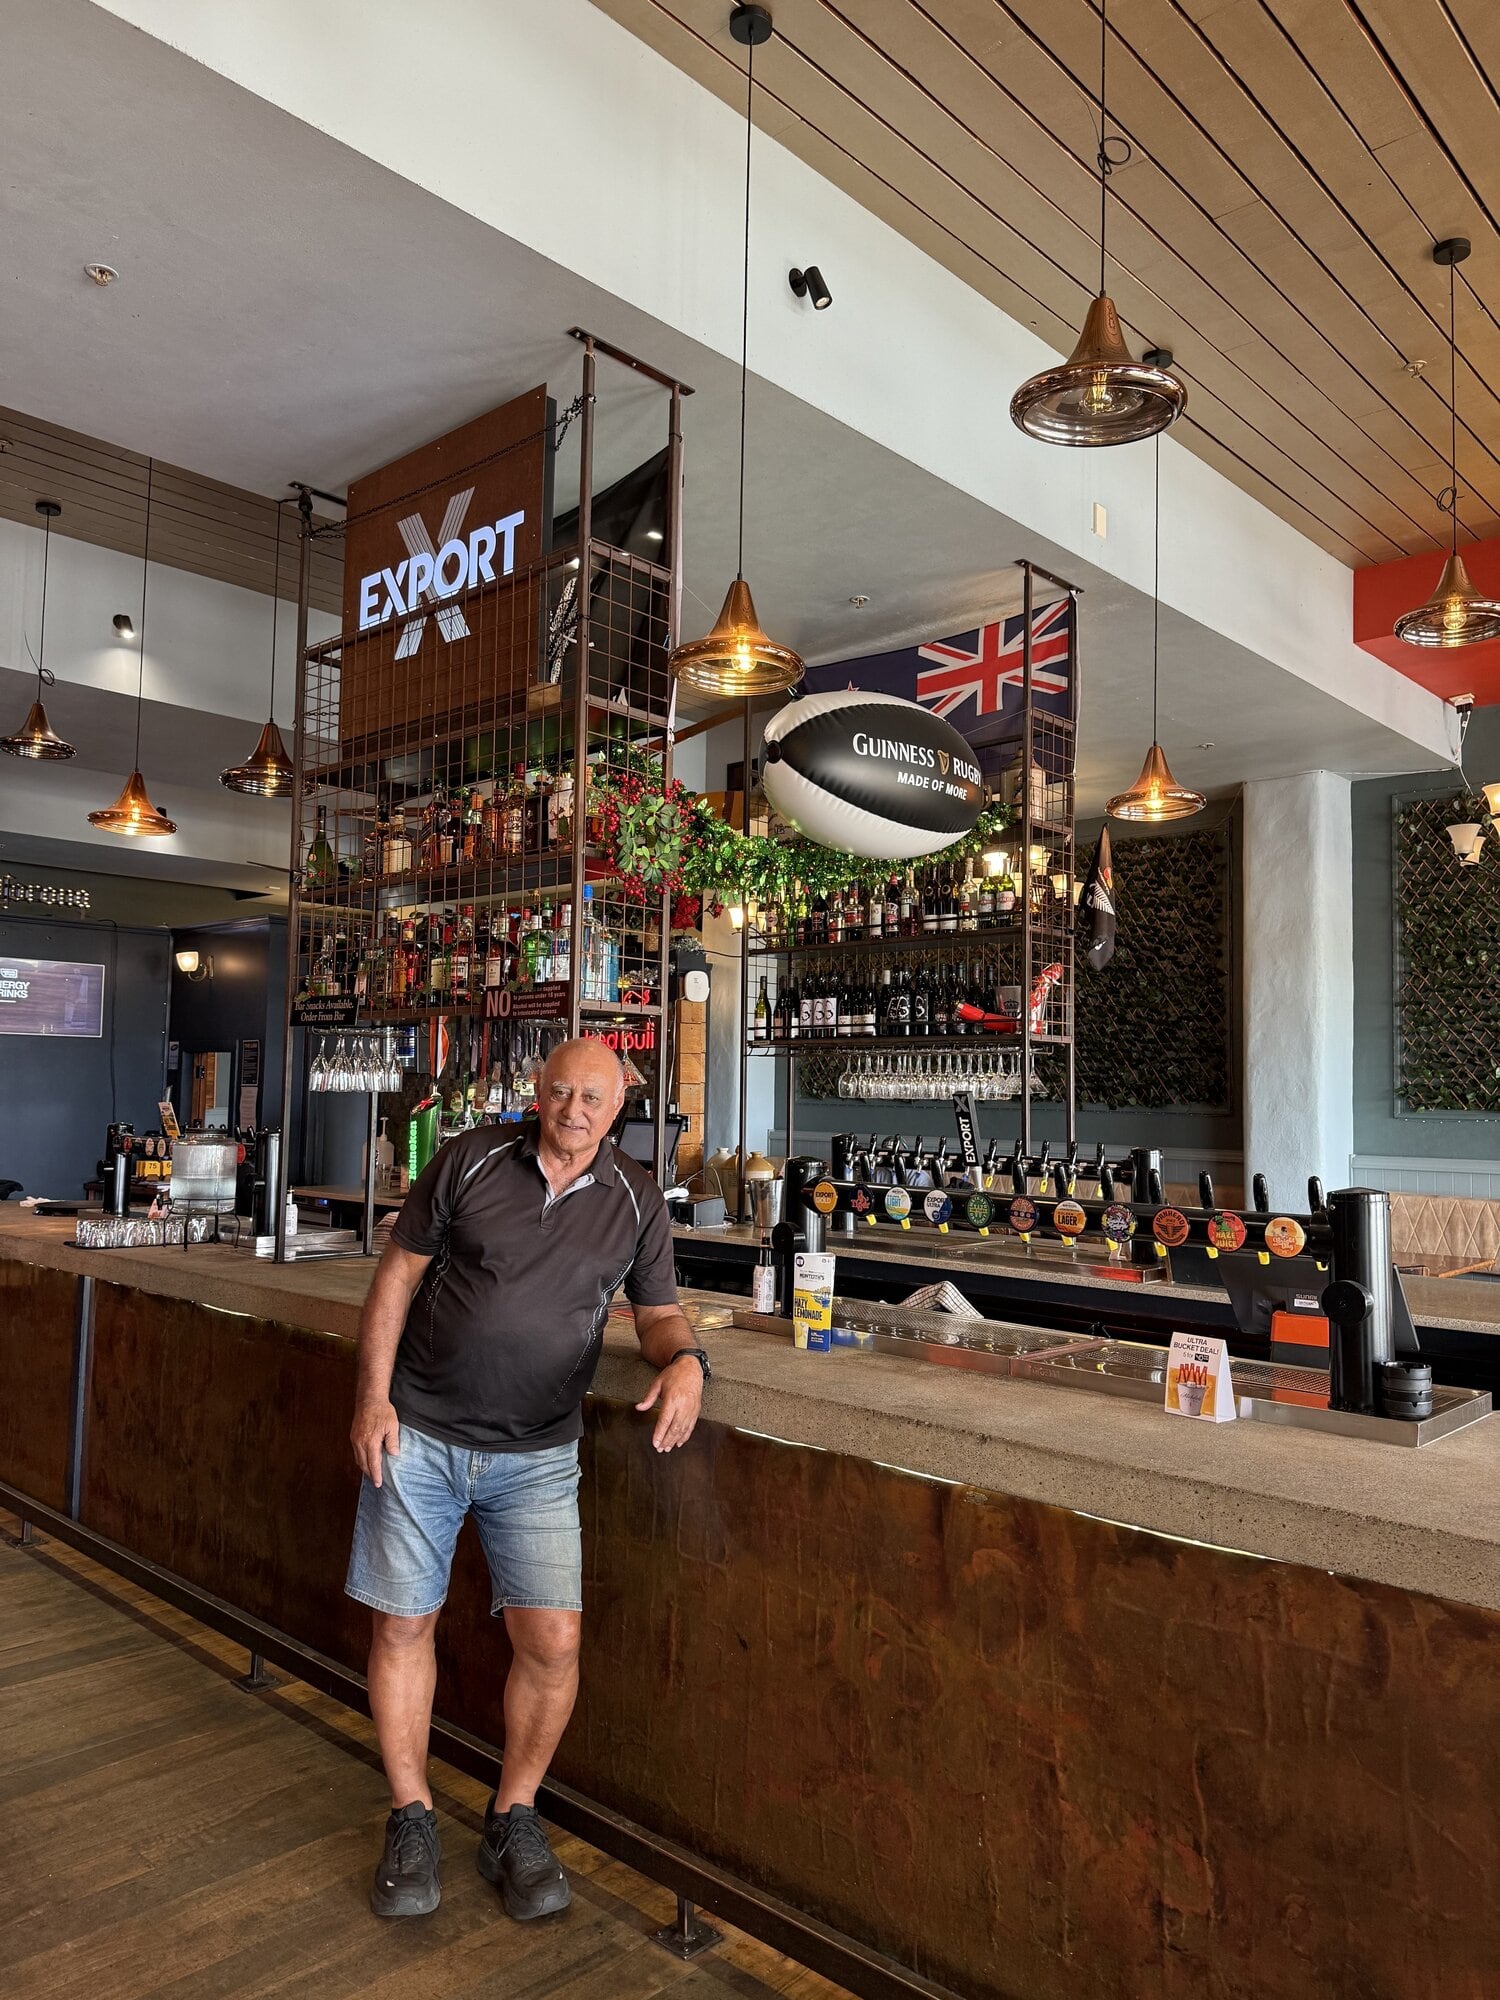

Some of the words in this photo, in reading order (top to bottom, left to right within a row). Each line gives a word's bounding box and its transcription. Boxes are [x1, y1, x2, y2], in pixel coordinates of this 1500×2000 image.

[359, 509, 525, 631] EXPORT
[852, 732, 935, 768] GUINNESS
[897, 771, 929, 789] MADE
[931, 779, 945, 792] OF
[945, 782, 968, 801] MORE
[0, 875, 91, 909] orona
[0, 980, 30, 990] ERGY
[326, 999, 354, 1010] Available.
[486, 990, 511, 1018] NO
[300, 1011, 318, 1022] Order
[318, 1011, 333, 1021] From
[334, 1010, 346, 1021] Bar
[959, 1116, 976, 1163] EXPORT
[408, 1120, 418, 1181] Heineken
[816, 1191, 834, 1199] EXPORT
[1058, 1215, 1078, 1226] LAGER
[1156, 1210, 1186, 1226] PANHEAD
[1215, 1231, 1236, 1240] HAZE
[1215, 1239, 1238, 1248] JUICE
[794, 1298, 808, 1309] HAZY
[794, 1307, 823, 1321] LEMONADE
[1173, 1341, 1200, 1352] BUCKET
[1200, 1346, 1220, 1355] DEAL!
[1187, 1337, 1208, 1346] ULTRA
